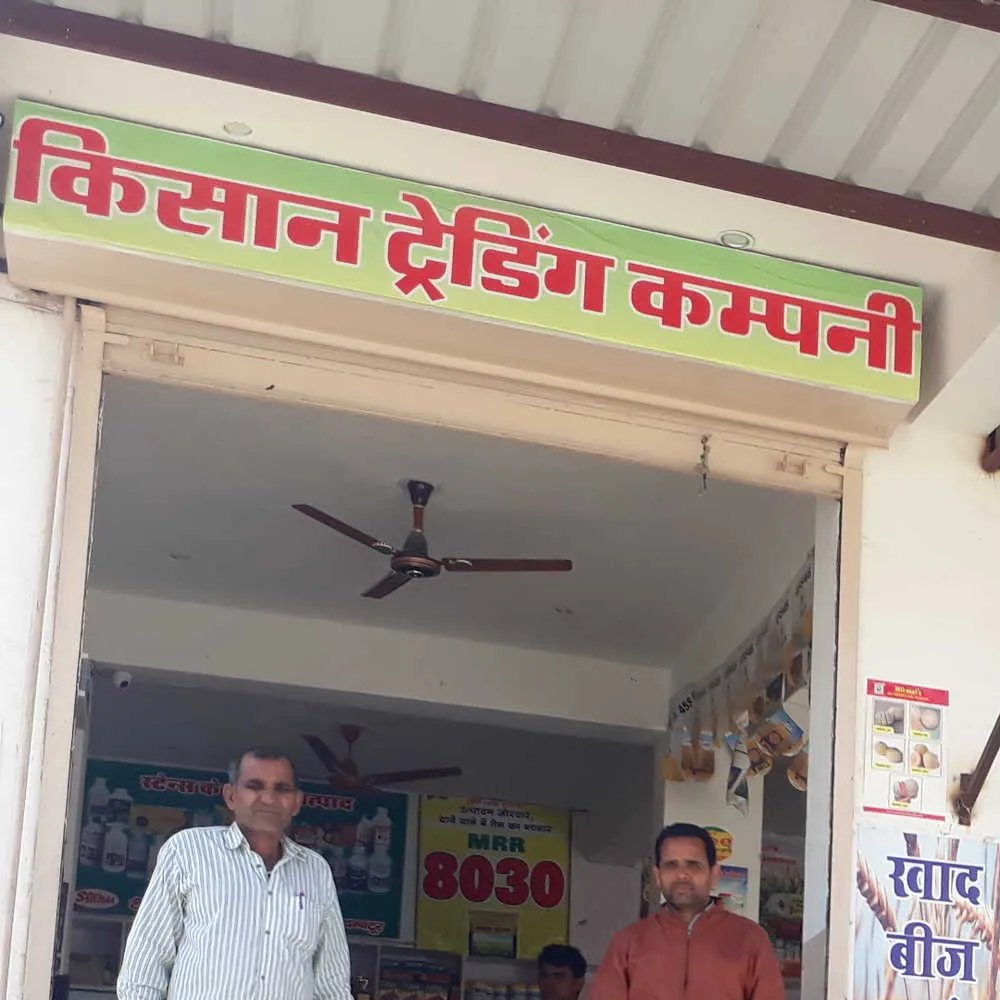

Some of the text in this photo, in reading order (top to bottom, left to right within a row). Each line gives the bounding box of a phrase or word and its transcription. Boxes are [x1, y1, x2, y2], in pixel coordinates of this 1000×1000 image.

[12, 116, 922, 376] किसान ट्रेडिंग कम्पनी
[467, 832, 528, 854] MRR
[422, 850, 566, 910] 8030
[887, 853, 983, 905] खाद
[887, 922, 979, 984] बीज
